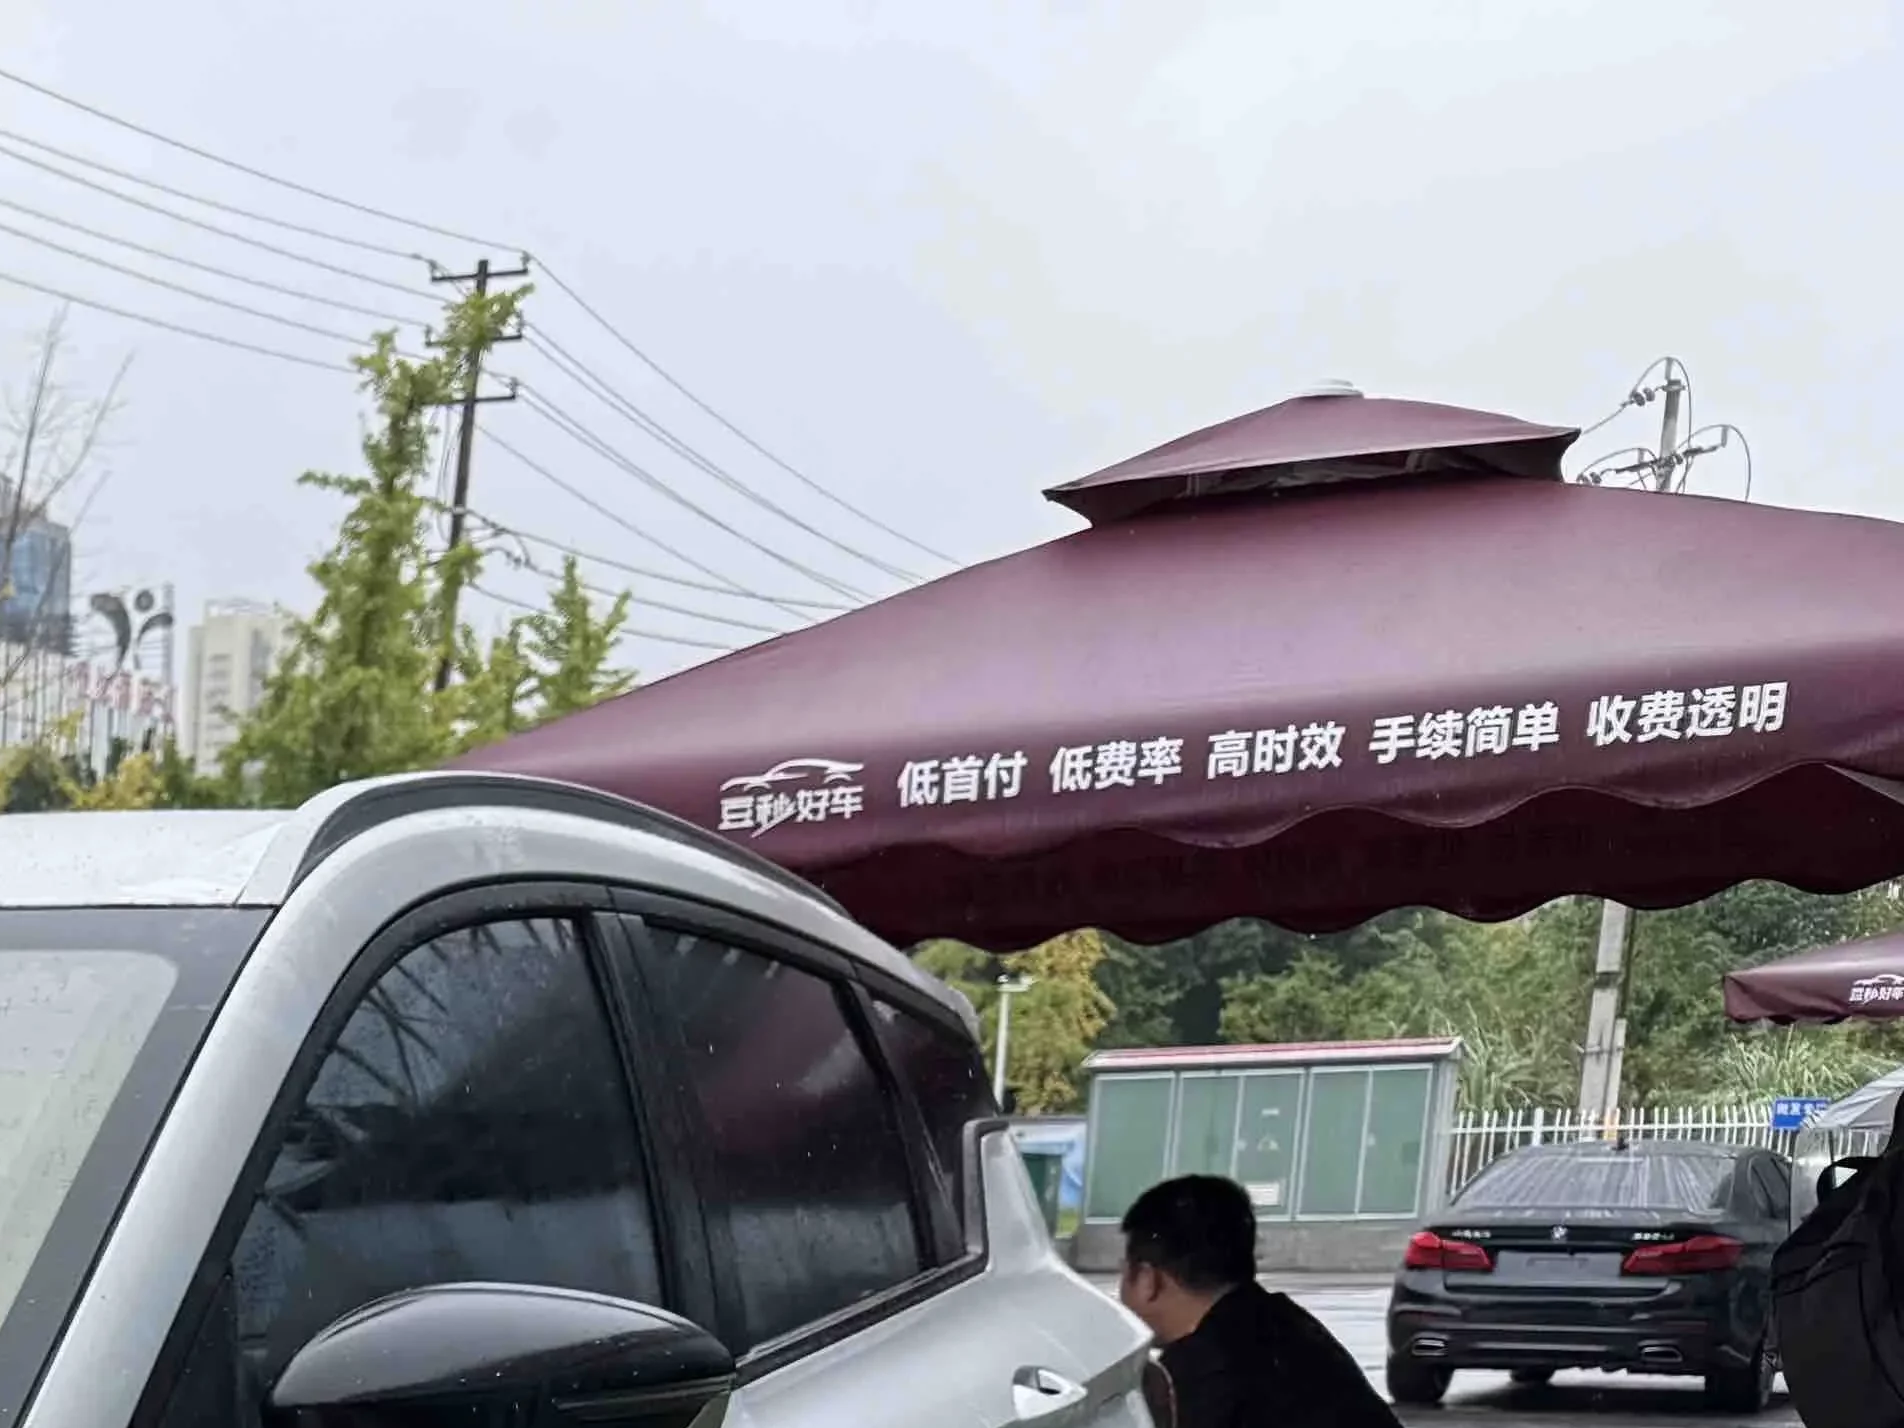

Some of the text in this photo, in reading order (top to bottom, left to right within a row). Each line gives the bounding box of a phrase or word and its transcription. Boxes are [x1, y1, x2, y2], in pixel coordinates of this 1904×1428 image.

[897, 751, 1029, 809] 低首付
[1049, 736, 1185, 794] 低费率
[1206, 723, 1346, 780] 高时效
[1368, 702, 1560, 765] 手续简单
[1585, 680, 1789, 748] 收费透明
